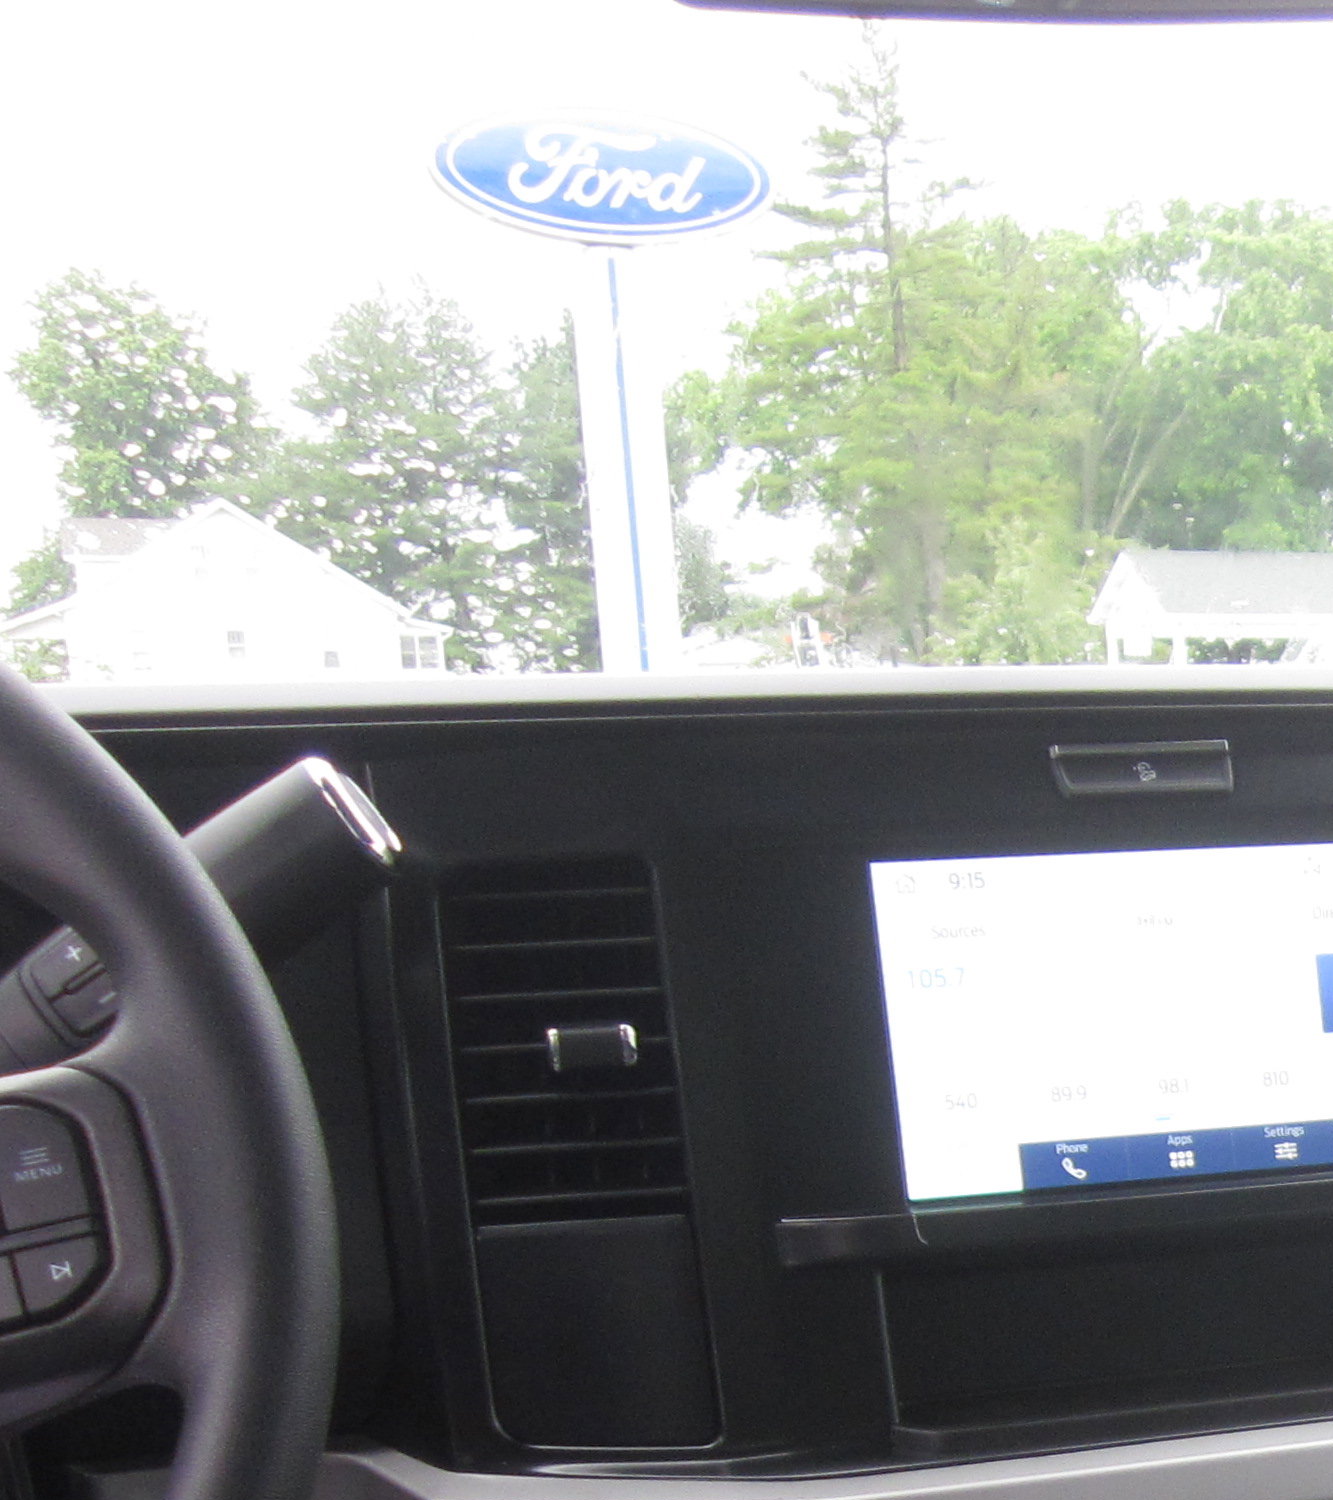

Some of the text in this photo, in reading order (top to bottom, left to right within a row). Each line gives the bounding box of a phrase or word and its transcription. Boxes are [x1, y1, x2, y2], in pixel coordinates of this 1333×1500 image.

[508, 123, 706, 214] Ford
[948, 871, 987, 890] 9:15
[930, 923, 987, 939] Sources
[906, 967, 966, 988] 105.7
[1262, 1069, 1290, 1087] 810
[945, 1092, 979, 1111] 540
[1167, 1133, 1193, 1147] Apps
[1264, 1124, 1305, 1140] Settings
[1055, 1141, 1089, 1155] Phone
[14, 1164, 62, 1182] MENU
